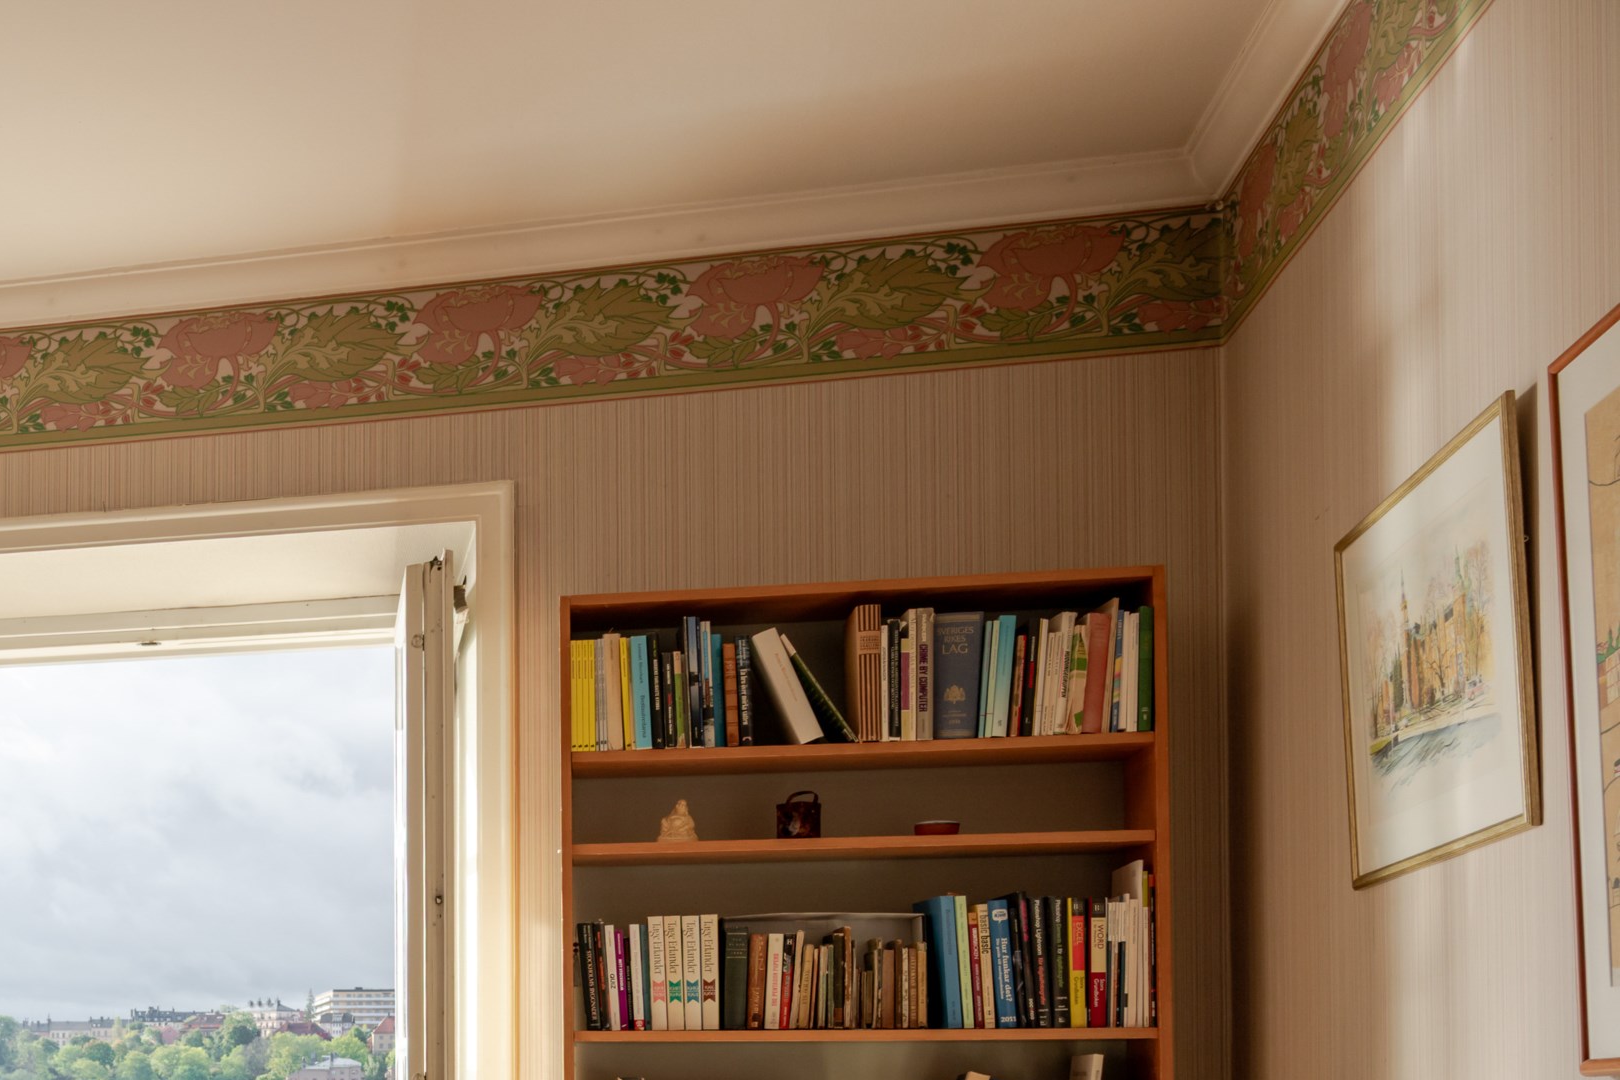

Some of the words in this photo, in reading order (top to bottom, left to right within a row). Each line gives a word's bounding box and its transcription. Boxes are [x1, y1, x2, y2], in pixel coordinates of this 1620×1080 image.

[919, 643, 929, 665] CRIME
[942, 643, 969, 655] LAG
[919, 676, 929, 713] COMPUTER
[649, 922, 662, 941] Tage
[665, 921, 678, 940] Tage
[683, 920, 697, 940] Tage
[701, 920, 714, 939] Tage
[981, 935, 990, 954] basic
[653, 941, 662, 975] Erlander
[669, 940, 678, 974] Erlander
[688, 940, 697, 974] Erlander
[705, 939, 714, 973] Erlander
[587, 950, 595, 987] STOCKHOLMS
[1002, 955, 1011, 982] funkar
[1004, 984, 1013, 1002] det?
